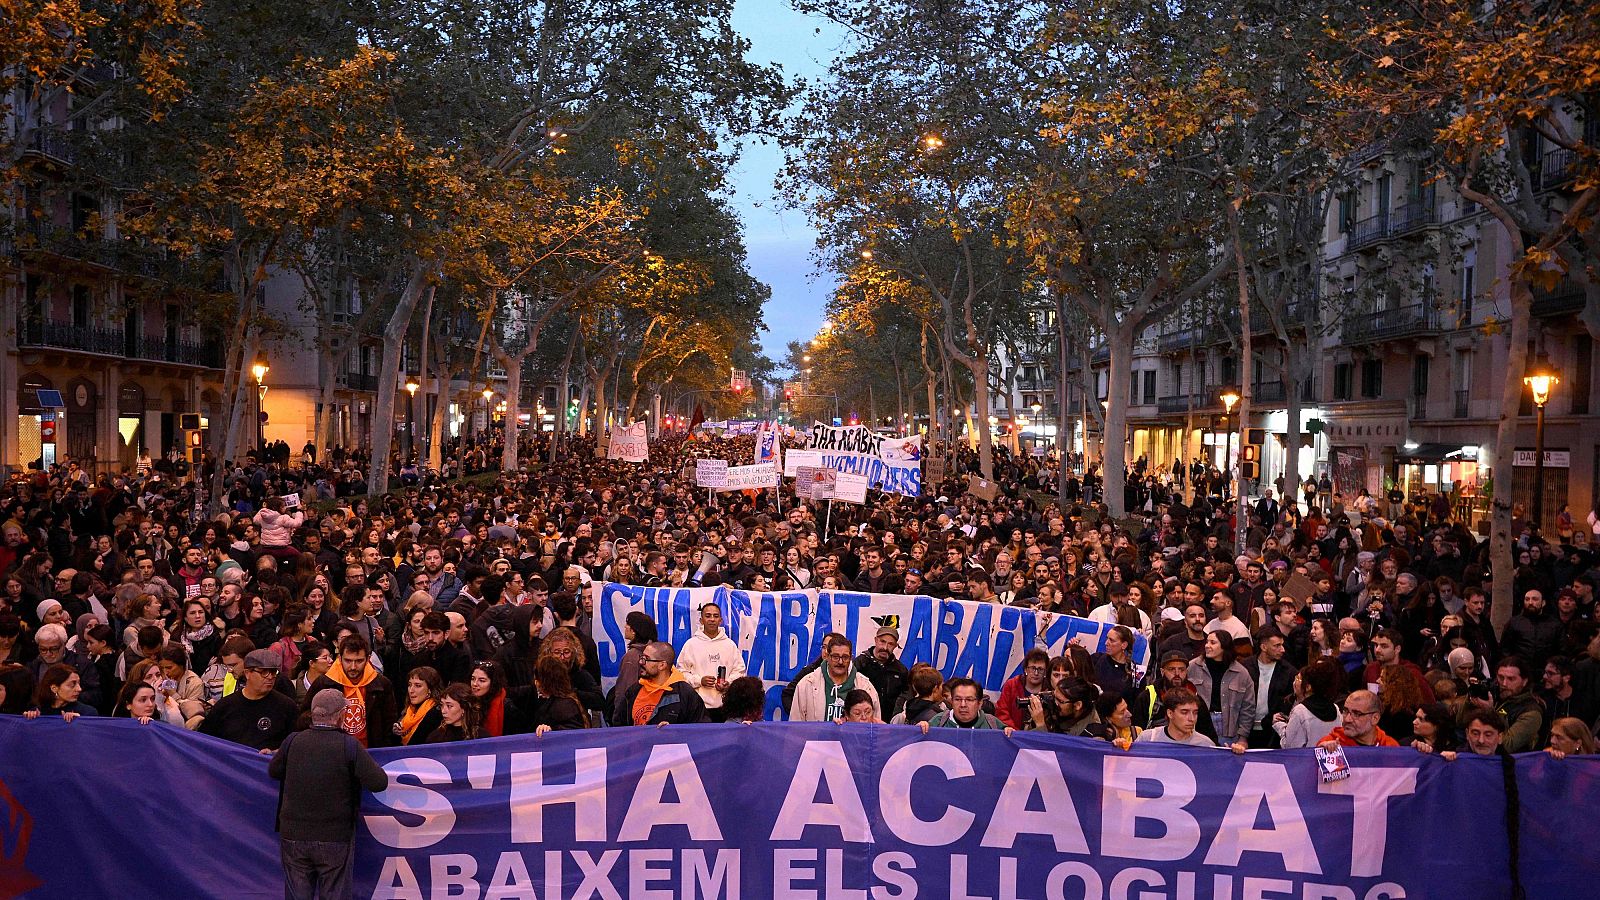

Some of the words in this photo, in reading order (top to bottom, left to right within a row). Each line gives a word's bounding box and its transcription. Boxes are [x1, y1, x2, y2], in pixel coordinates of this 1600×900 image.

[1330, 425, 1399, 436] FARMACIA
[1520, 452, 1551, 462] DAIR
[1326, 756, 1335, 765] 23
[364, 743, 724, 849] S'HA
[769, 741, 1419, 877] ACABAT
[371, 849, 741, 900] ABAIXEM
[773, 848, 919, 900] ELS
